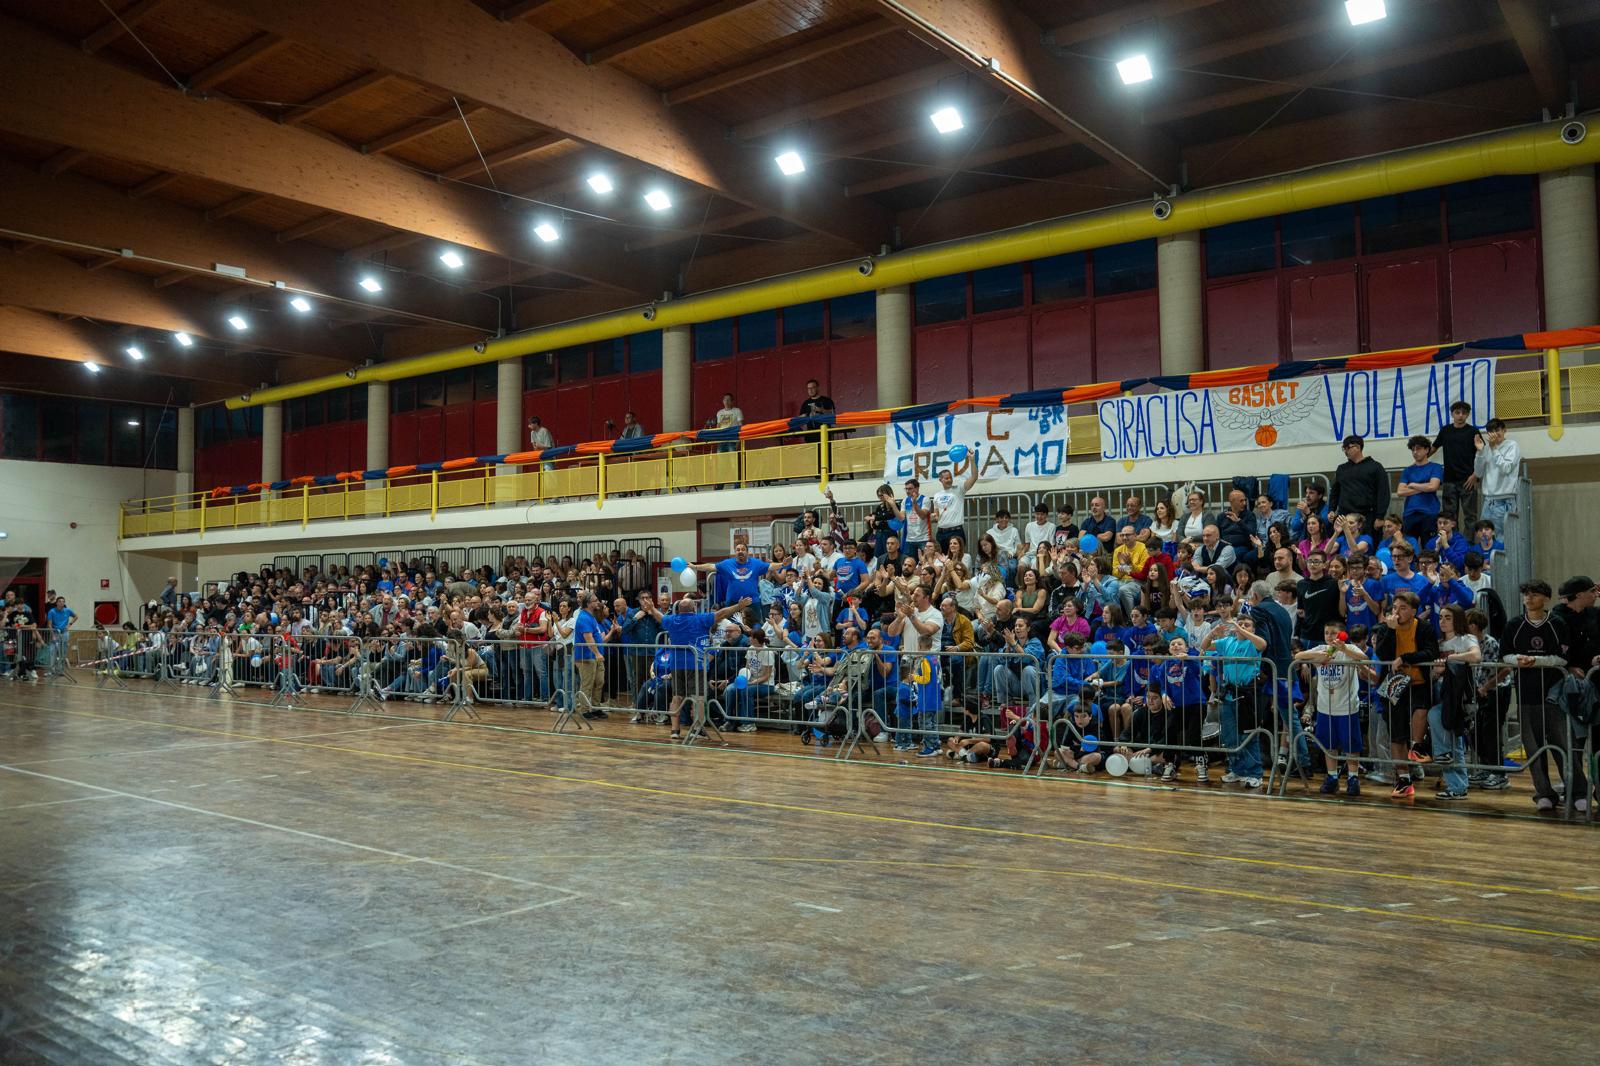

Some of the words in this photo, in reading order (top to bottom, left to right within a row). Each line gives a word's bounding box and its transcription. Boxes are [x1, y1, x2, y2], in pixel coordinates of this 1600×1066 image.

[1229, 381, 1299, 408] BASKET
[1324, 368, 1409, 441] VOLA
[894, 414, 955, 450] NOI
[986, 407, 1014, 441] C
[1099, 389, 1217, 459] SIRACUSA
